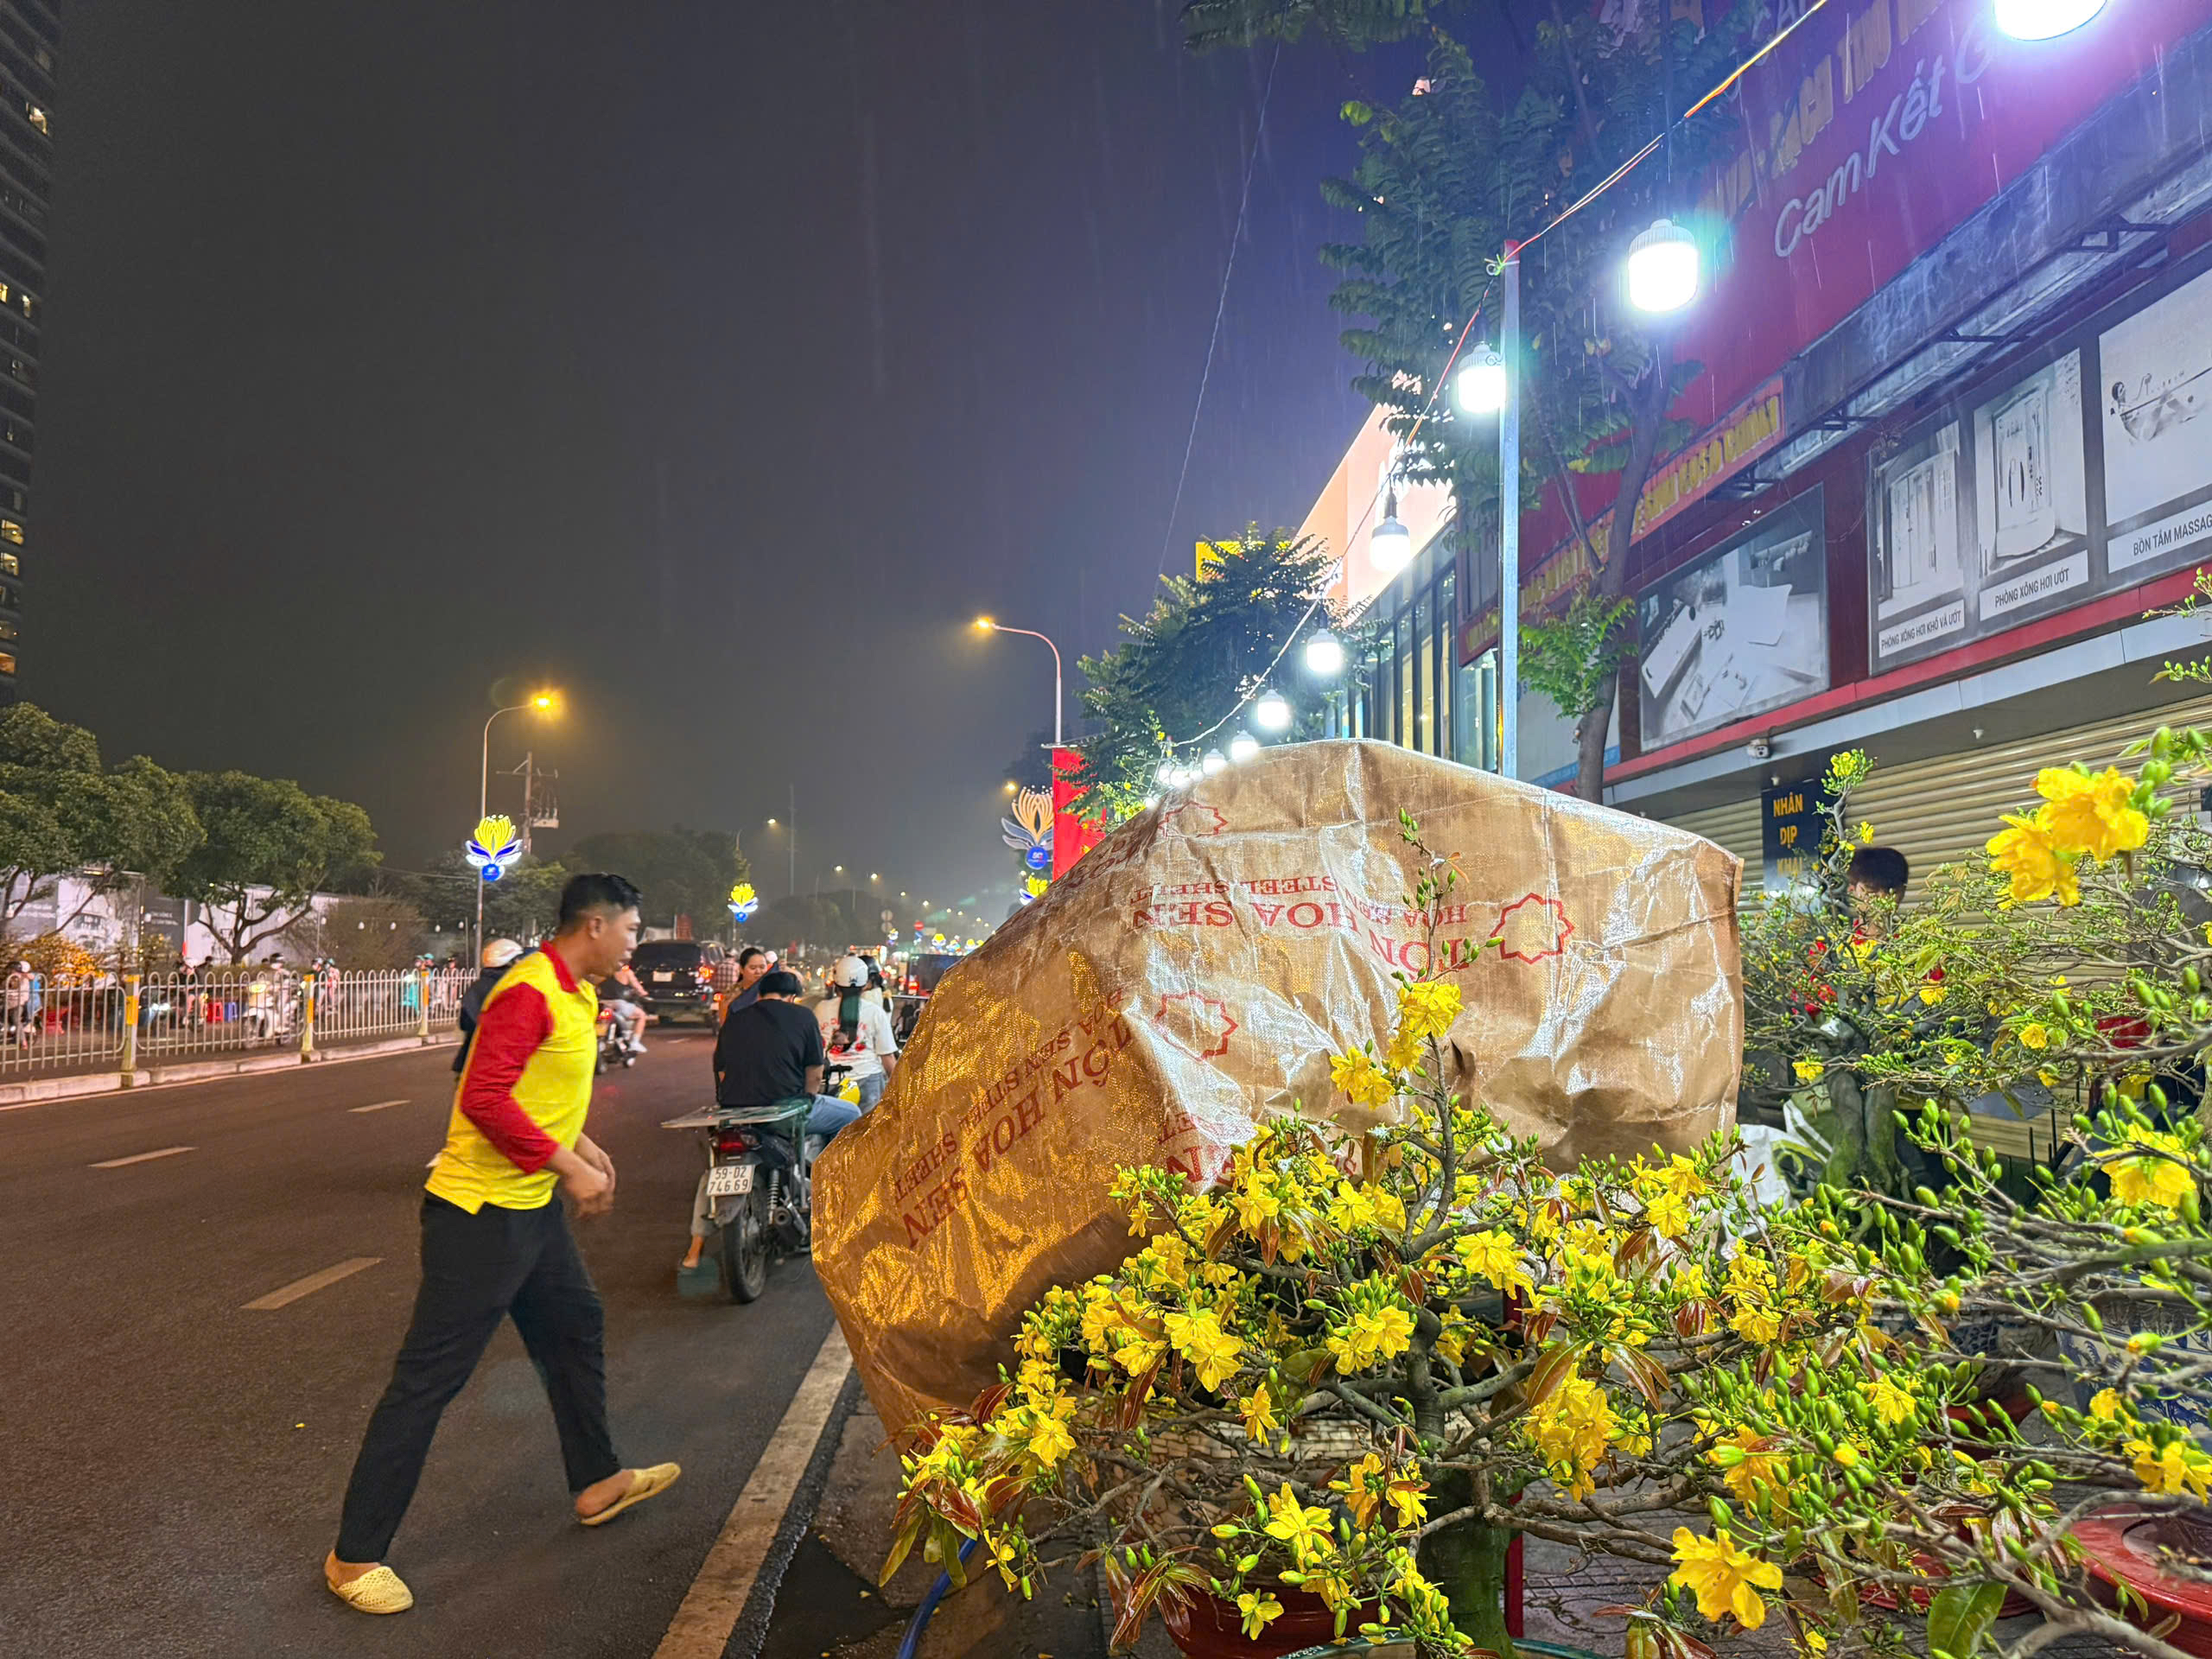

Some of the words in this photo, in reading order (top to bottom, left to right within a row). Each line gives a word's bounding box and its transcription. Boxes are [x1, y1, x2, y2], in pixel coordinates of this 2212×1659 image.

[1774, 151, 1860, 257] Cam
[1866, 54, 1945, 180] Kết
[1994, 588, 2018, 608] PHÒNG
[2019, 580, 2039, 599] XÔNG
[2039, 574, 2053, 589] HƠI
[2053, 566, 2070, 586] ƯỚT
[1880, 633, 1900, 651] PHÒNG
[1773, 791, 1804, 818] NHÂN
[1779, 824, 1798, 850] DỊP
[1240, 875, 1340, 895] STEEL
[1077, 988, 1124, 1037] HOA
[1025, 1029, 1072, 1079] SEN
[1052, 1014, 1132, 1106] TÔN
[969, 1085, 1046, 1174] HOA
[893, 1131, 957, 1204] SHEET
[901, 1166, 969, 1249] SEN
